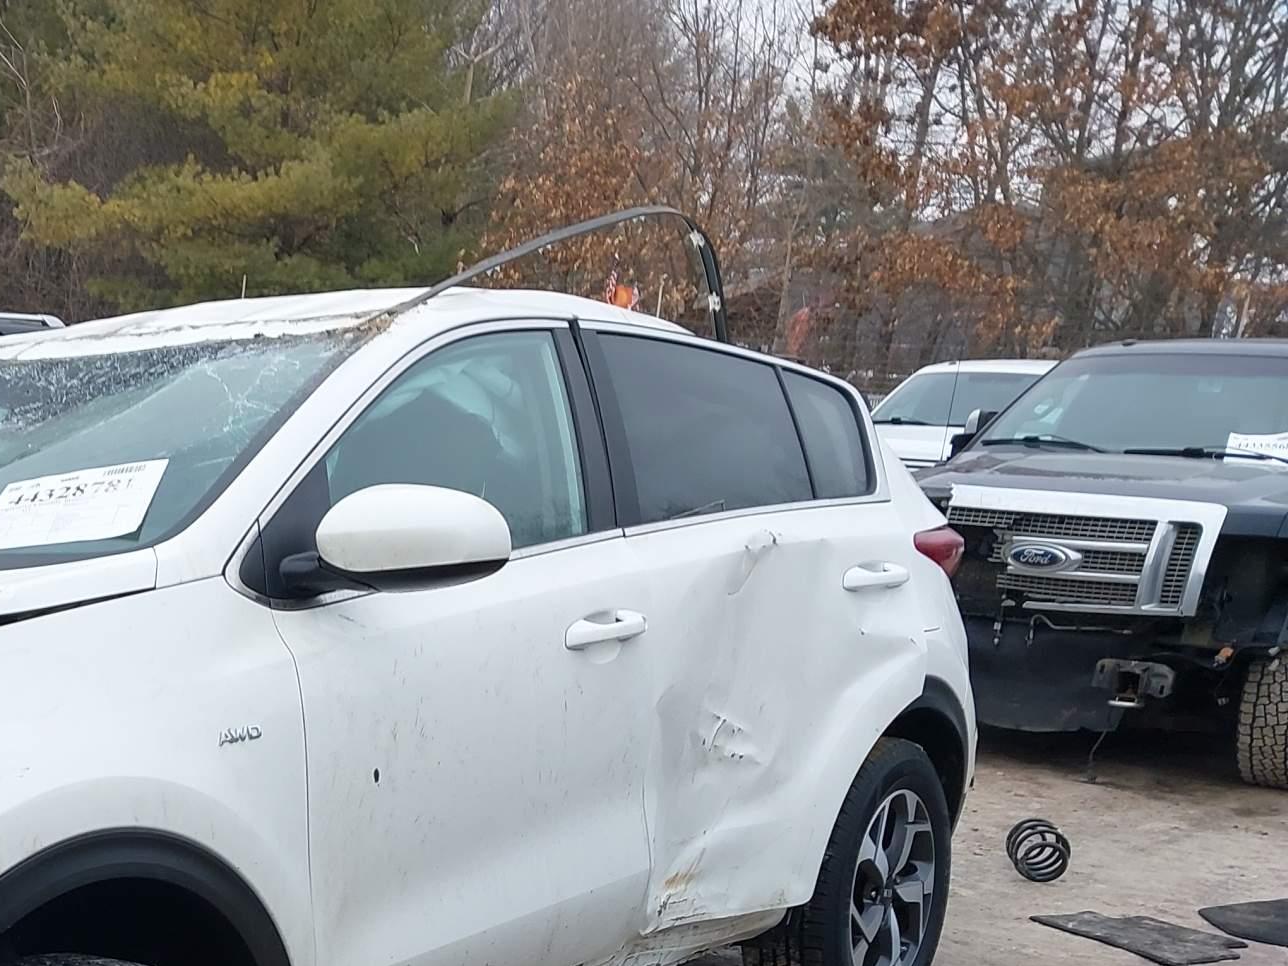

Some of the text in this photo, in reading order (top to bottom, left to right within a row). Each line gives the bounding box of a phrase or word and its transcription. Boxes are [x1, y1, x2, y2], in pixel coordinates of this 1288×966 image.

[9, 477, 133, 506] 44328781
[1020, 548, 1052, 564] Ford
[218, 725, 262, 747] AWD
